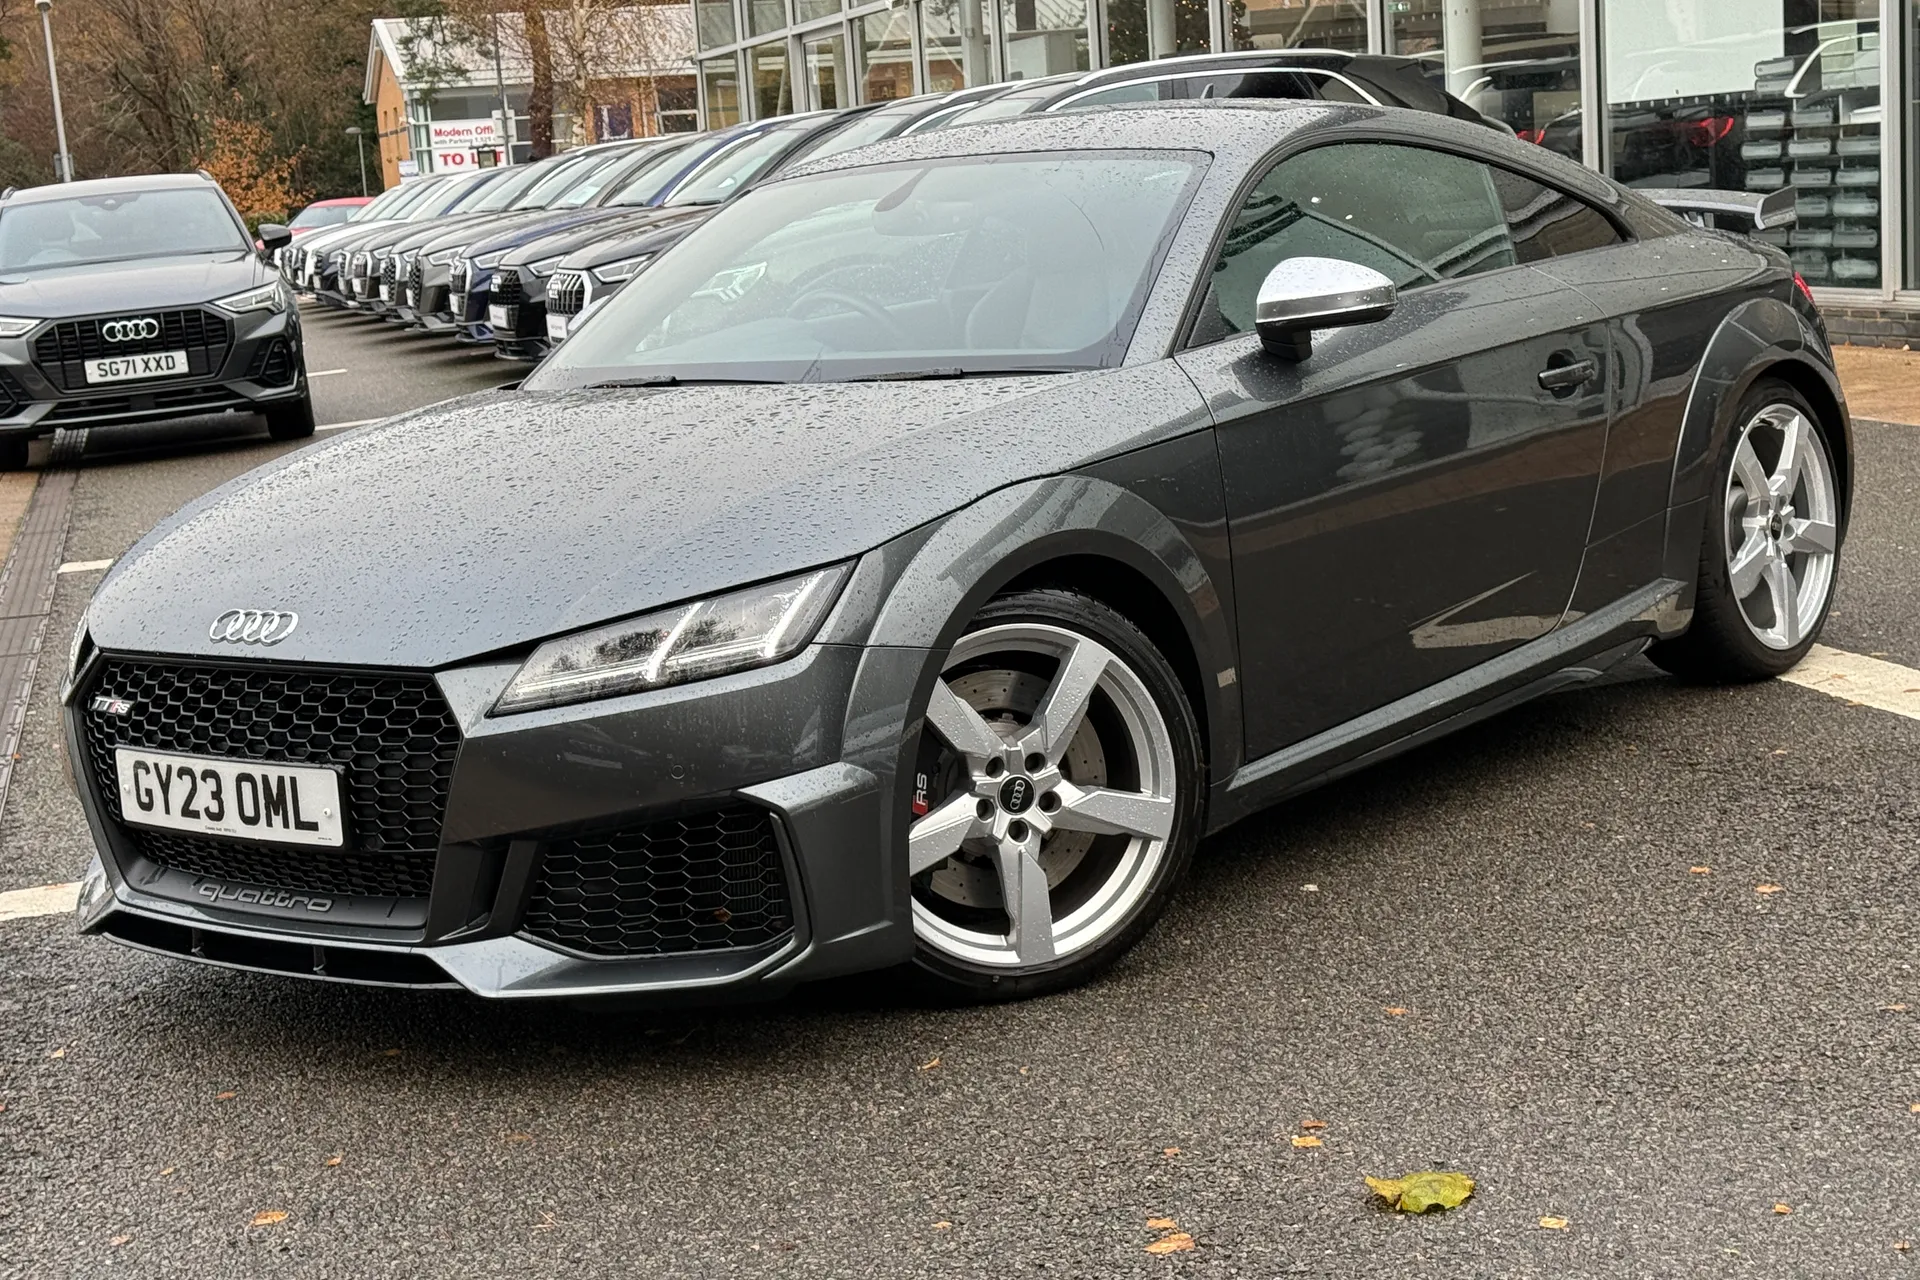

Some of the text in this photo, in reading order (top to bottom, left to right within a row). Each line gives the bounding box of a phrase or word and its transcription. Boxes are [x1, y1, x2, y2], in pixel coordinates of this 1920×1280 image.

[434, 125, 495, 137] Modern Offi
[439, 151, 504, 166] TO LT
[97, 355, 176, 377] SG71 XXD
[133, 760, 319, 831] GY23 OML
[916, 772, 928, 806] RS
[199, 882, 333, 912] quattro
